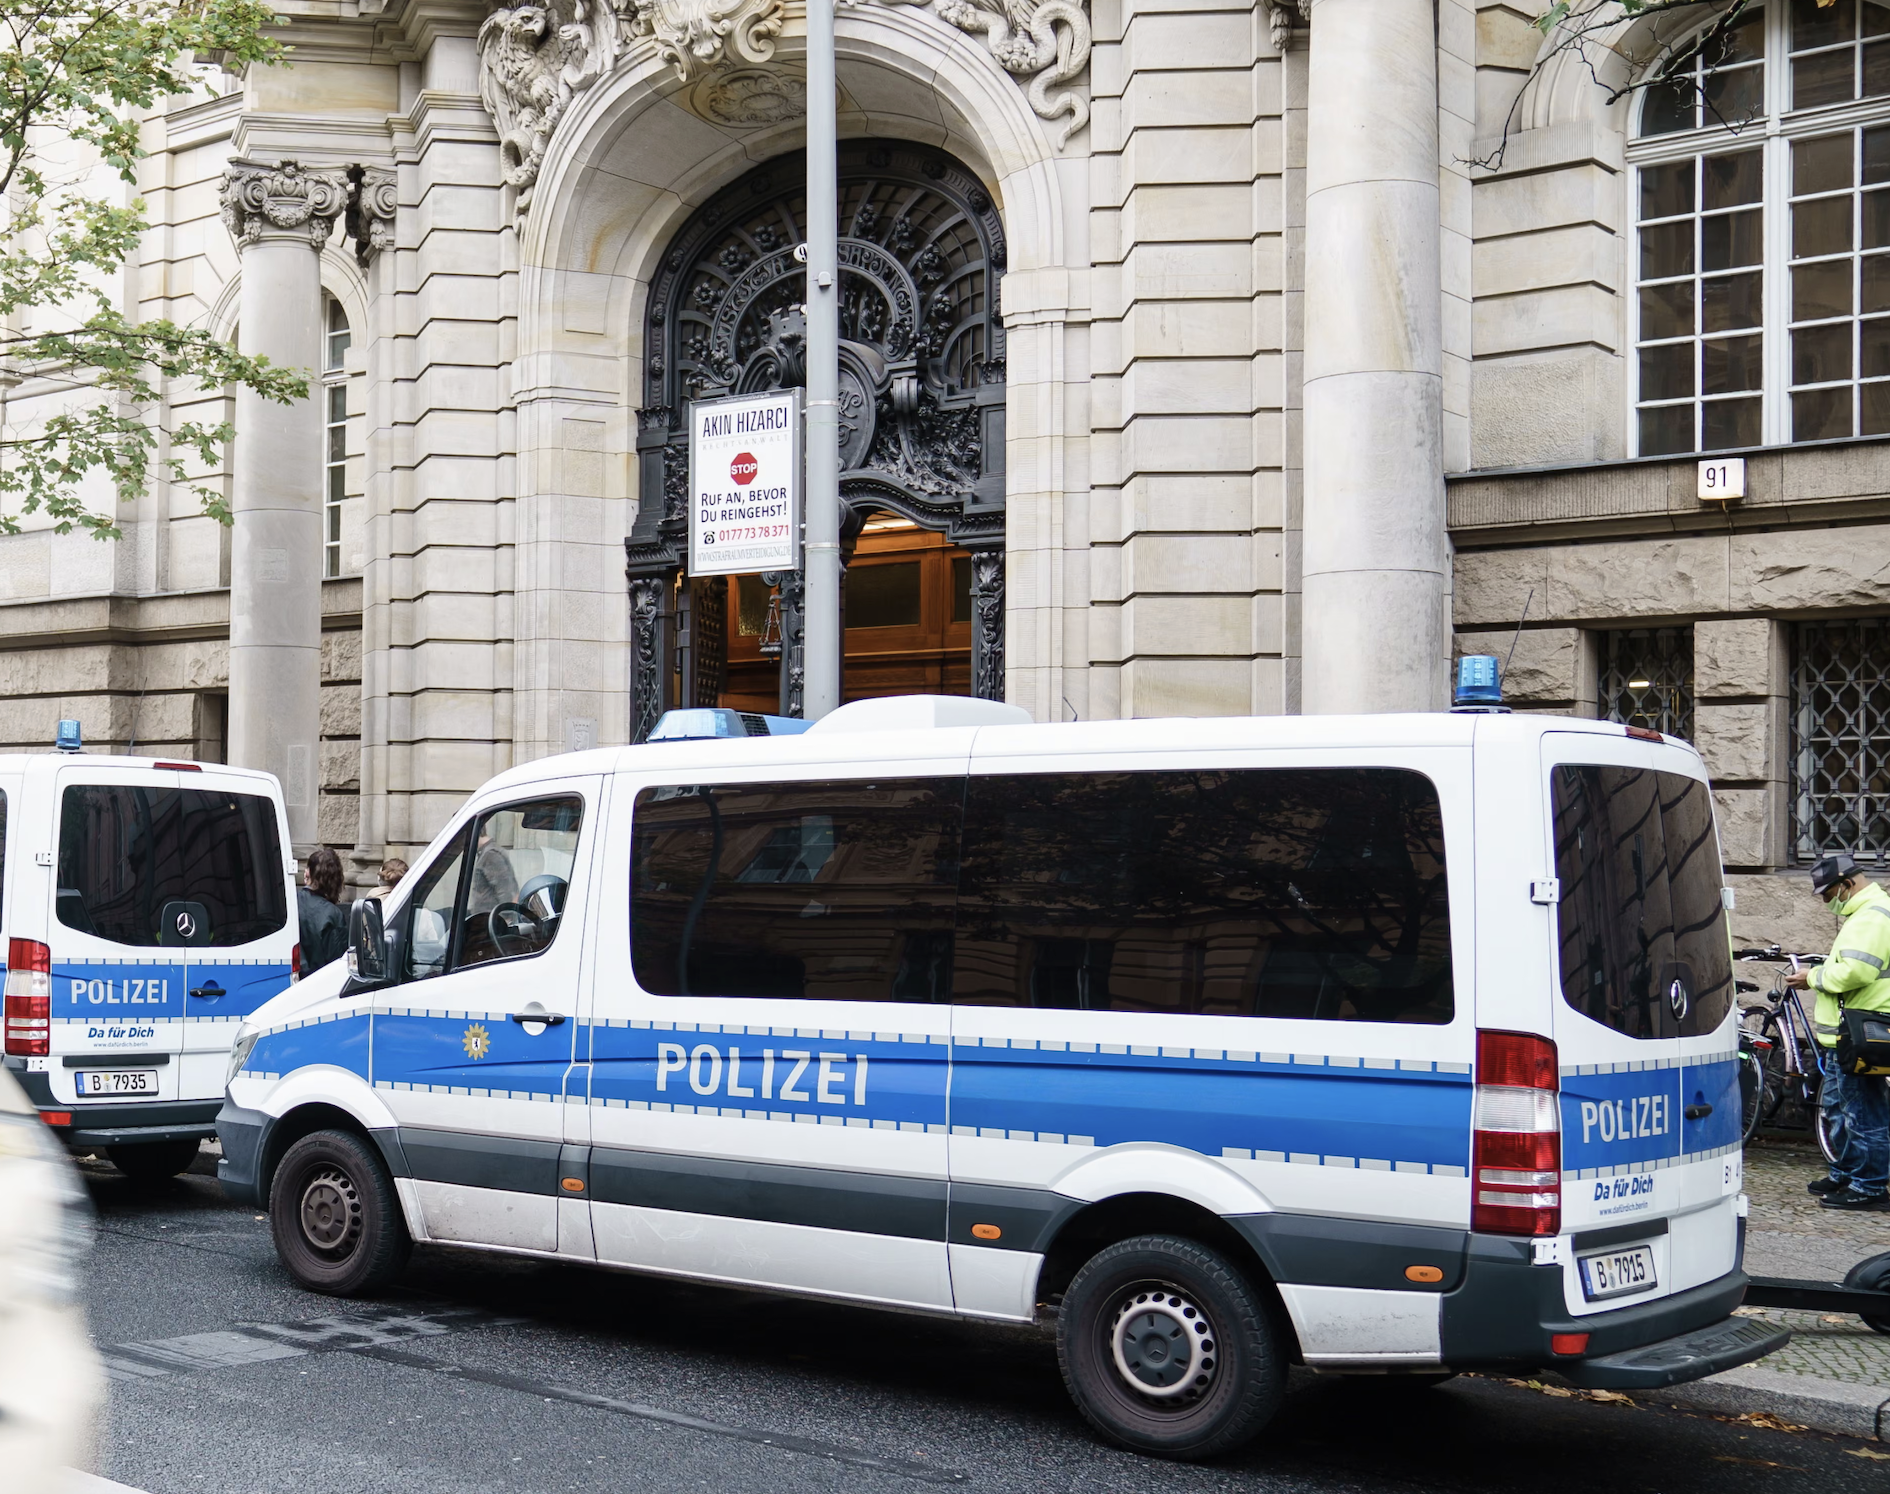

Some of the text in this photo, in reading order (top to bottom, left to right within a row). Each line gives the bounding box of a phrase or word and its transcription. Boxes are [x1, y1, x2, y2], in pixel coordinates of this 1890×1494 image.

[703, 407, 787, 438] AKIN HIZARCI
[731, 463, 758, 475] STOP
[1706, 466, 1726, 488] 91
[725, 491, 745, 506] AN,
[749, 487, 787, 502] BEVOR
[721, 500, 787, 521] REINGEHST!
[719, 524, 789, 542] 0177 73 78 371
[71, 979, 168, 1004] POLIZEI
[88, 1026, 154, 1039] Da für Dich
[92, 1075, 102, 1091] B
[113, 1074, 147, 1091] 7935
[656, 1042, 868, 1106] POLIZEI
[1581, 1094, 1669, 1144] POLIZEI
[1594, 1174, 1653, 1201] Da für Dich
[1596, 1253, 1645, 1288] B 7915
